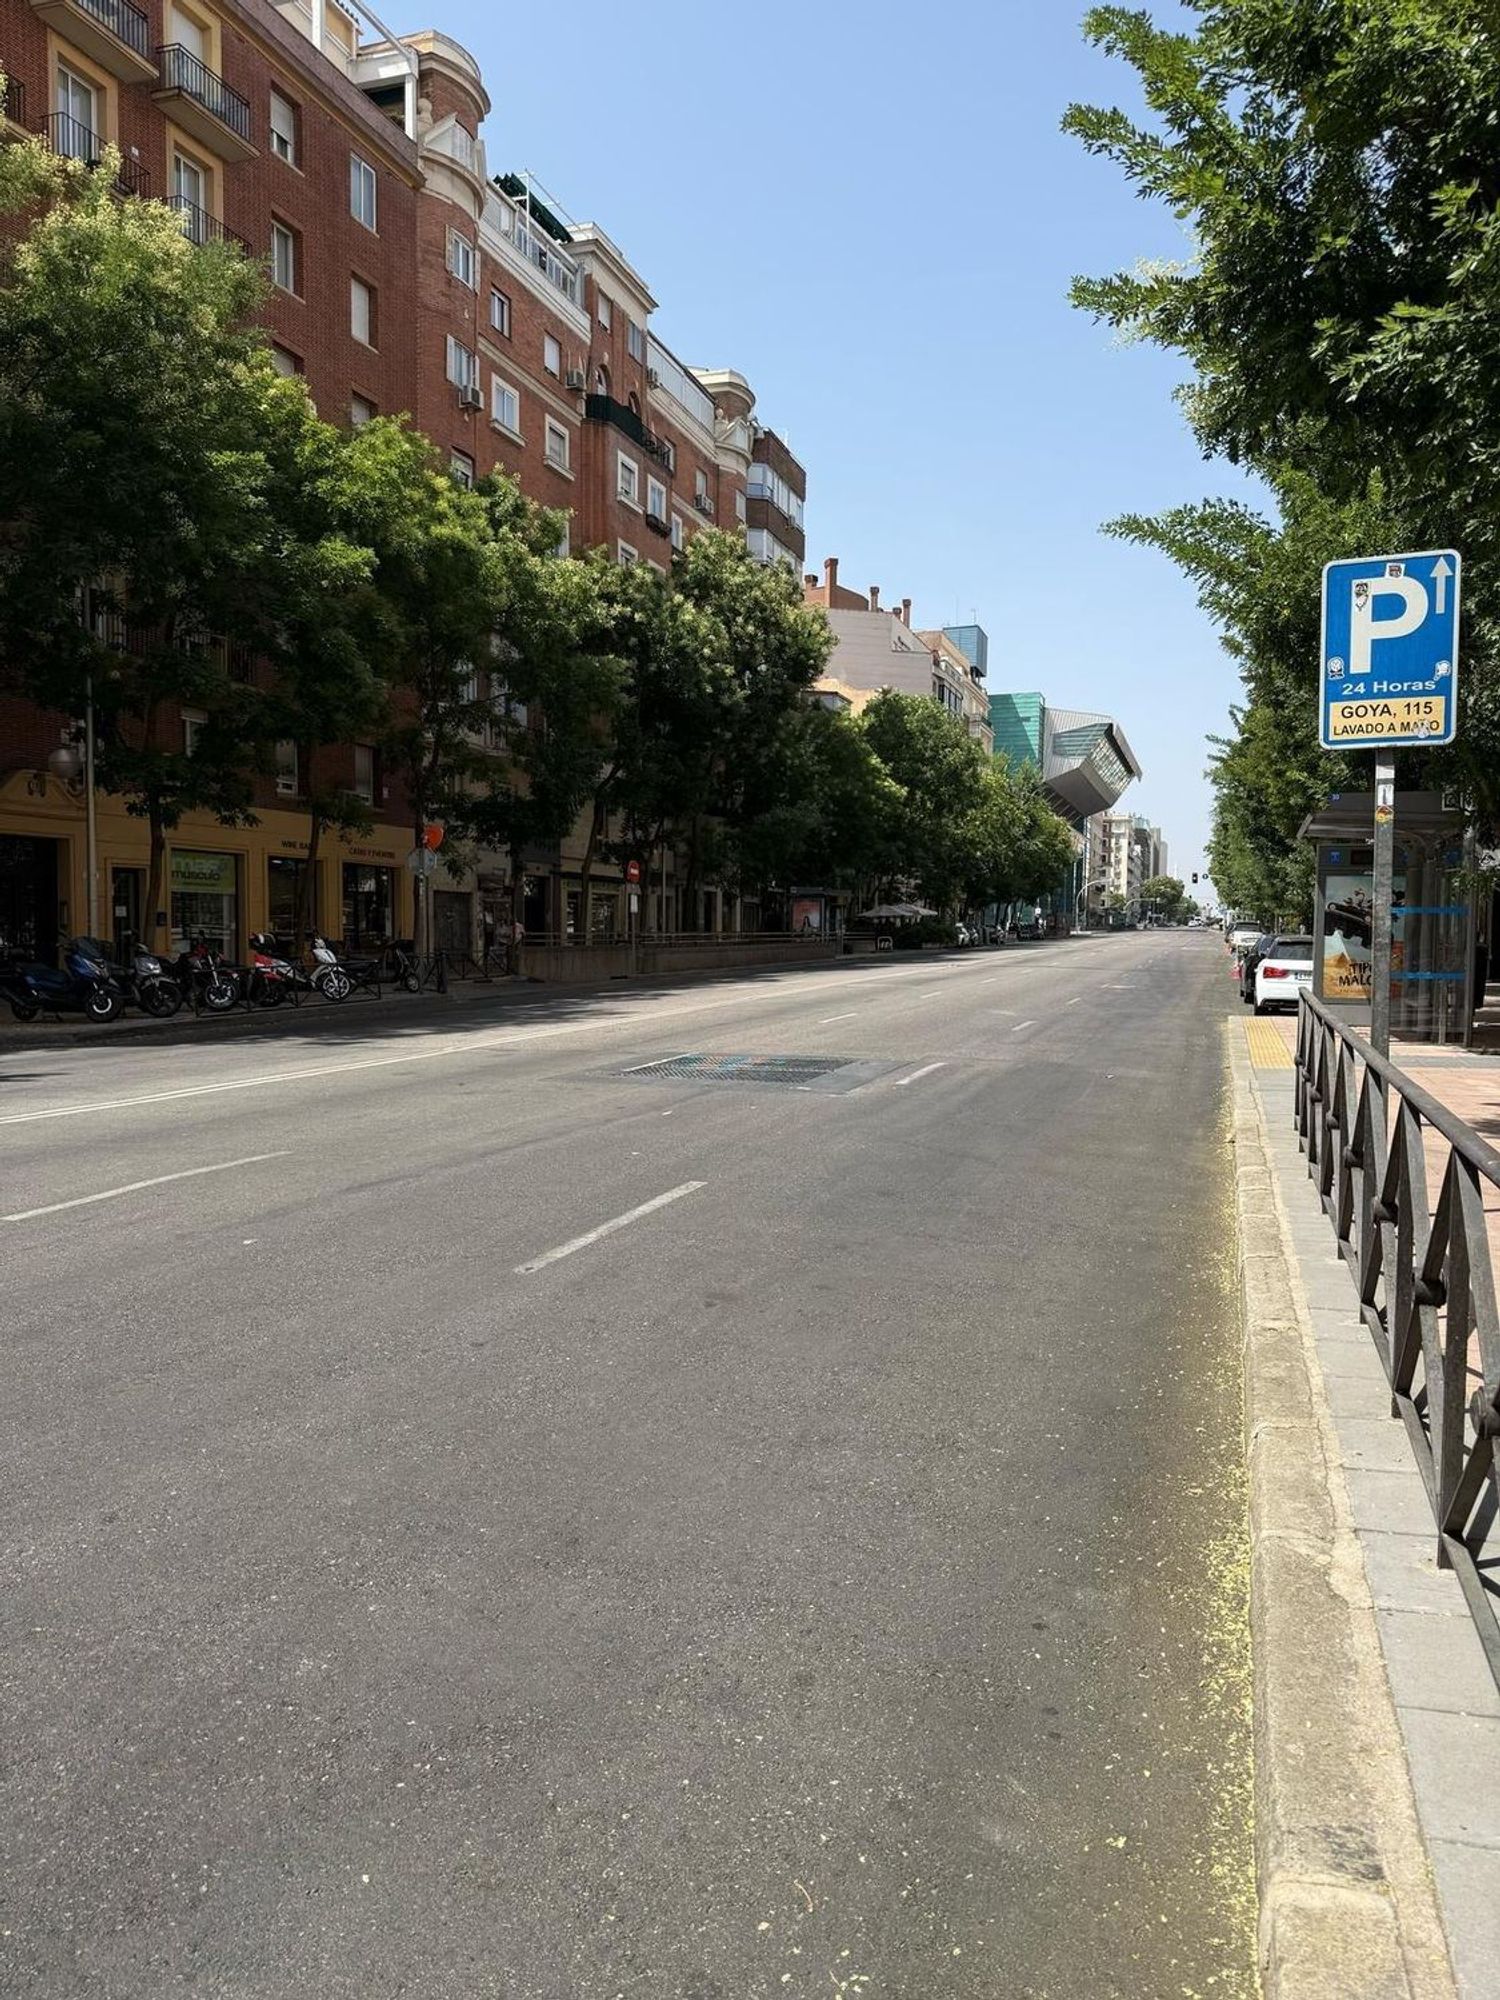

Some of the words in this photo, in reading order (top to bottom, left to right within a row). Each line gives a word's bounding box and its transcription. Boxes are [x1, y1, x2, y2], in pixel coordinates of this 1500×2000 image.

[1341, 682, 1366, 695] 24
[1373, 680, 1436, 693] Horas
[1341, 704, 1397, 719] GOYA,
[1403, 701, 1433, 715] 115
[1333, 722, 1384, 736] LAVADO
[1387, 724, 1396, 733] A
[1400, 720, 1440, 732] MAO
